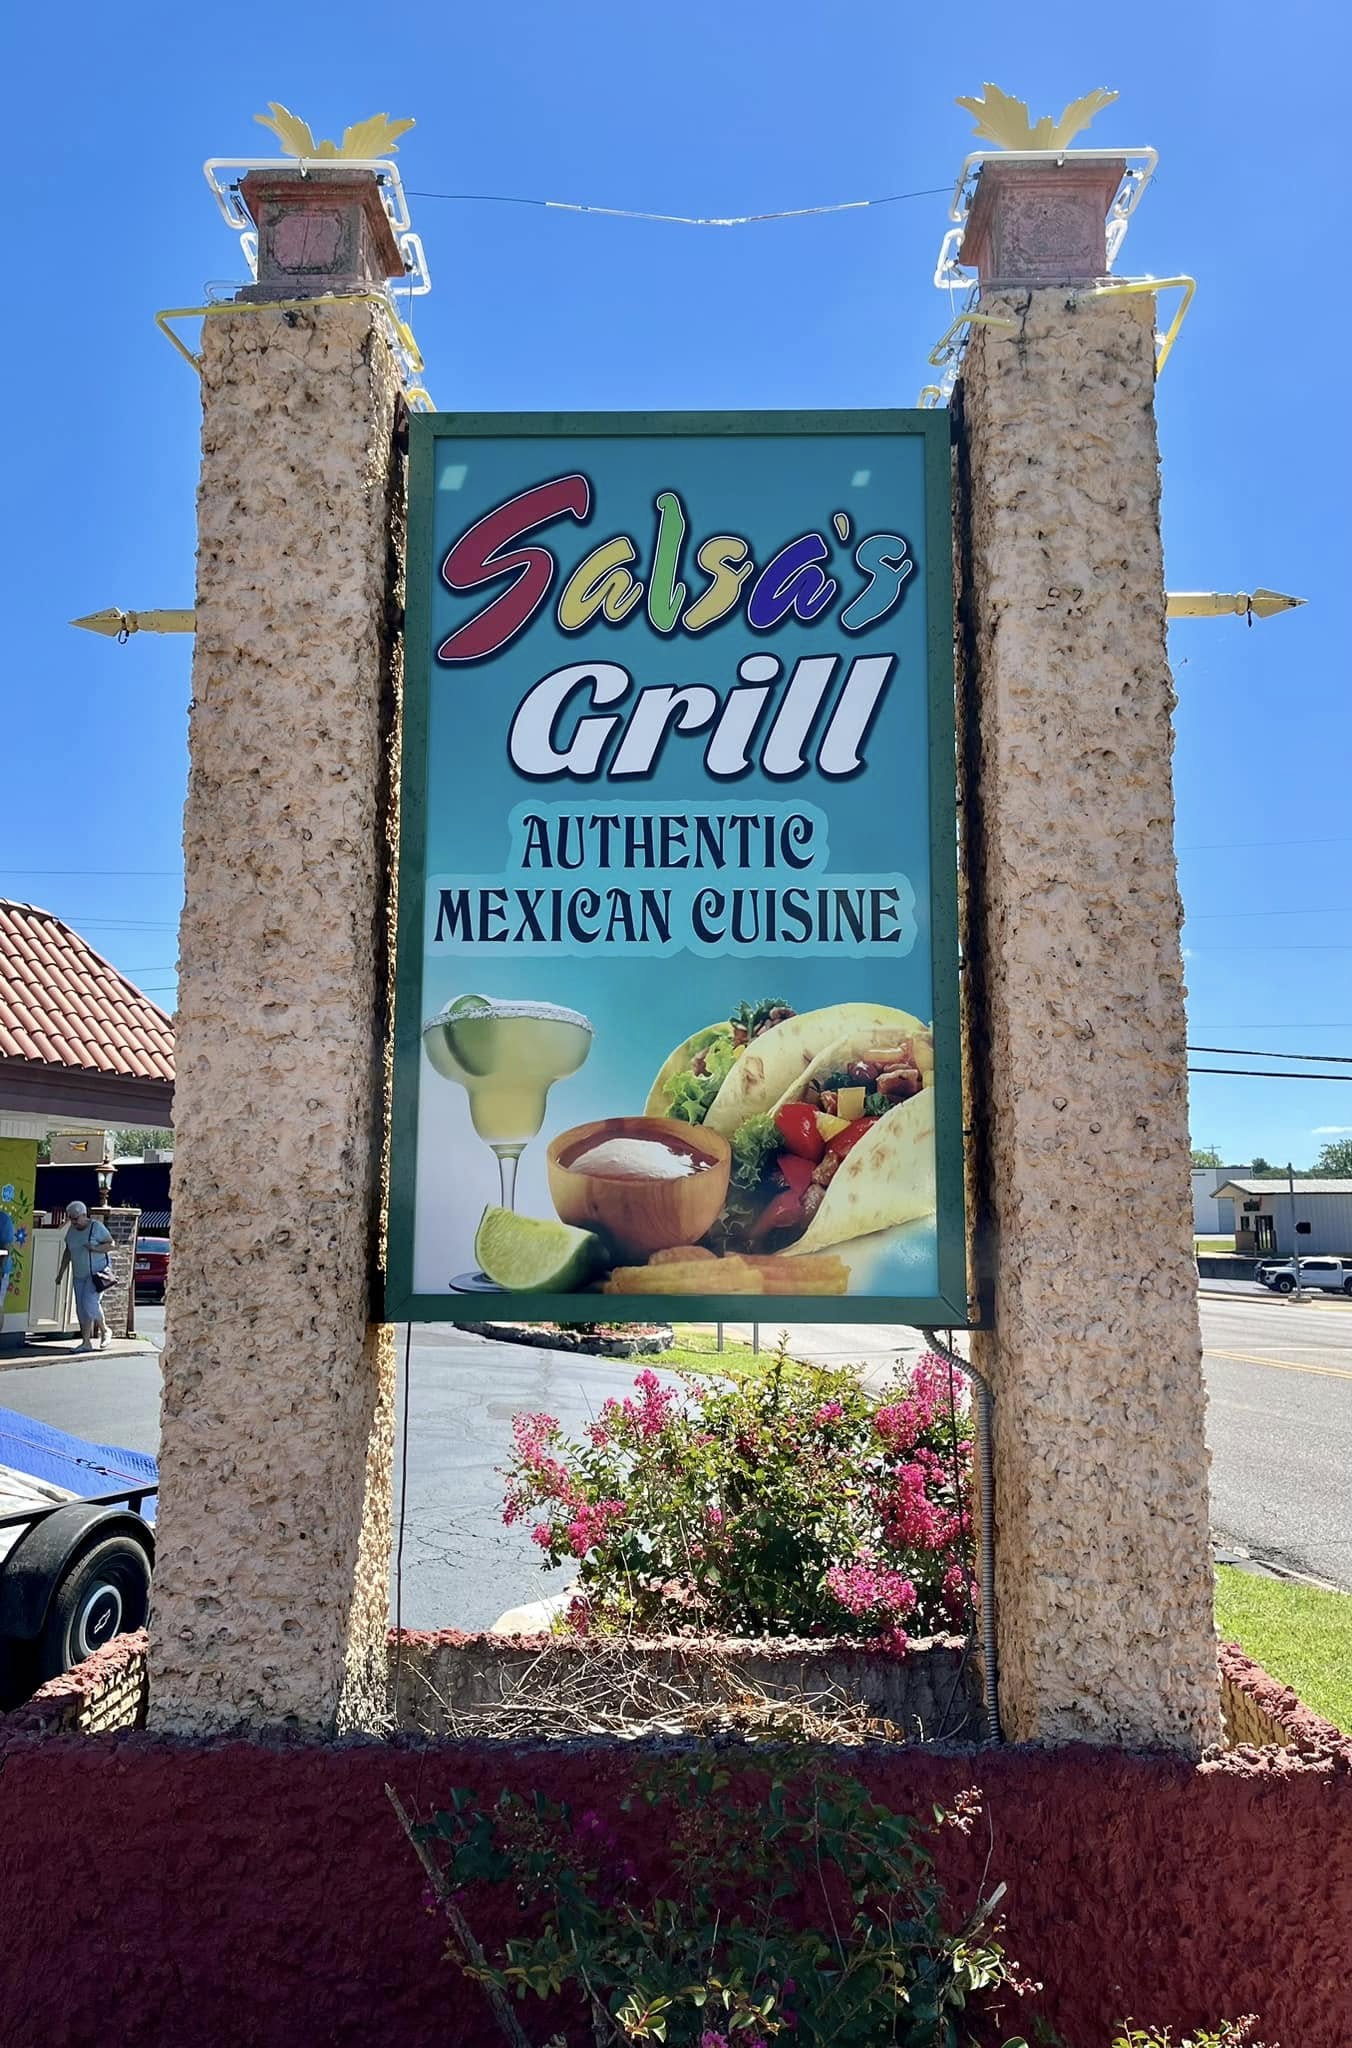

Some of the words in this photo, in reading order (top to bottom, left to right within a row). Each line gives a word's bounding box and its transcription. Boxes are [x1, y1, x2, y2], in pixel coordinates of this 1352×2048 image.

[437, 474, 914, 661] Salsa's
[506, 654, 895, 777] Grill
[521, 814, 815, 869] AUTHENTIC
[434, 887, 673, 943] MEXICAN
[691, 887, 903, 944] CUISINE
